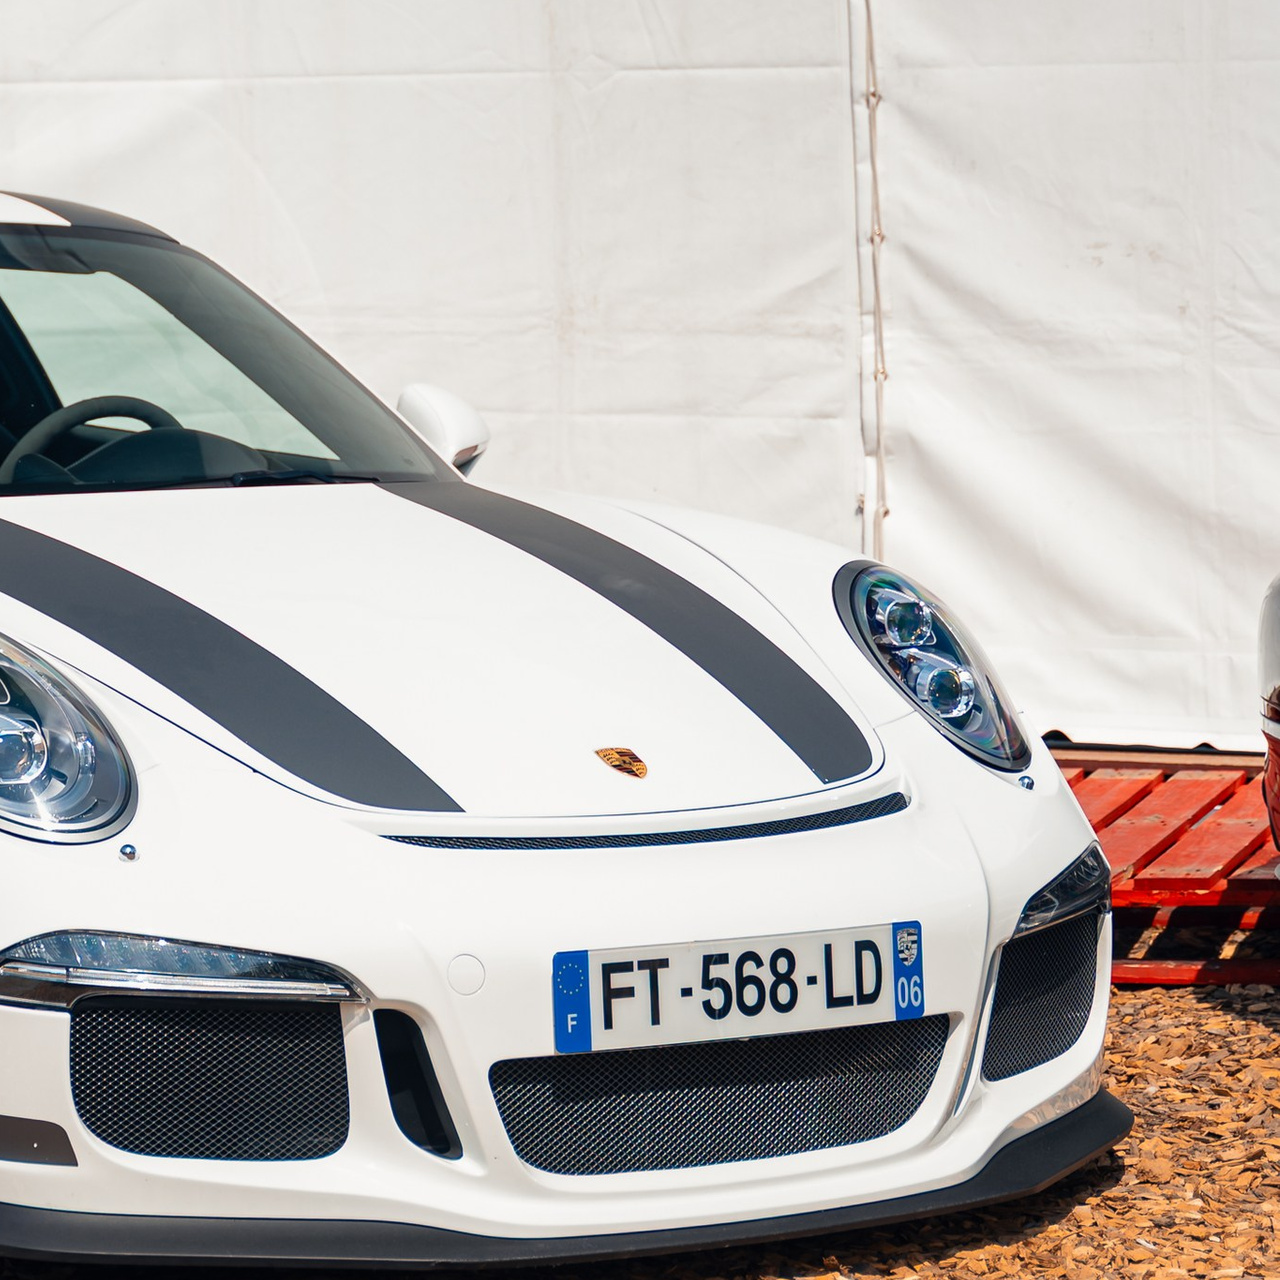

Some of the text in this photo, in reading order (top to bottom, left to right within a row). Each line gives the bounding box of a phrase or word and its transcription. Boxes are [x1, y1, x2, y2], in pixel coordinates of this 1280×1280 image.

[601, 939, 883, 1031] FT-568-LD
[897, 974, 922, 1009] 06
[566, 1013, 578, 1034] F
